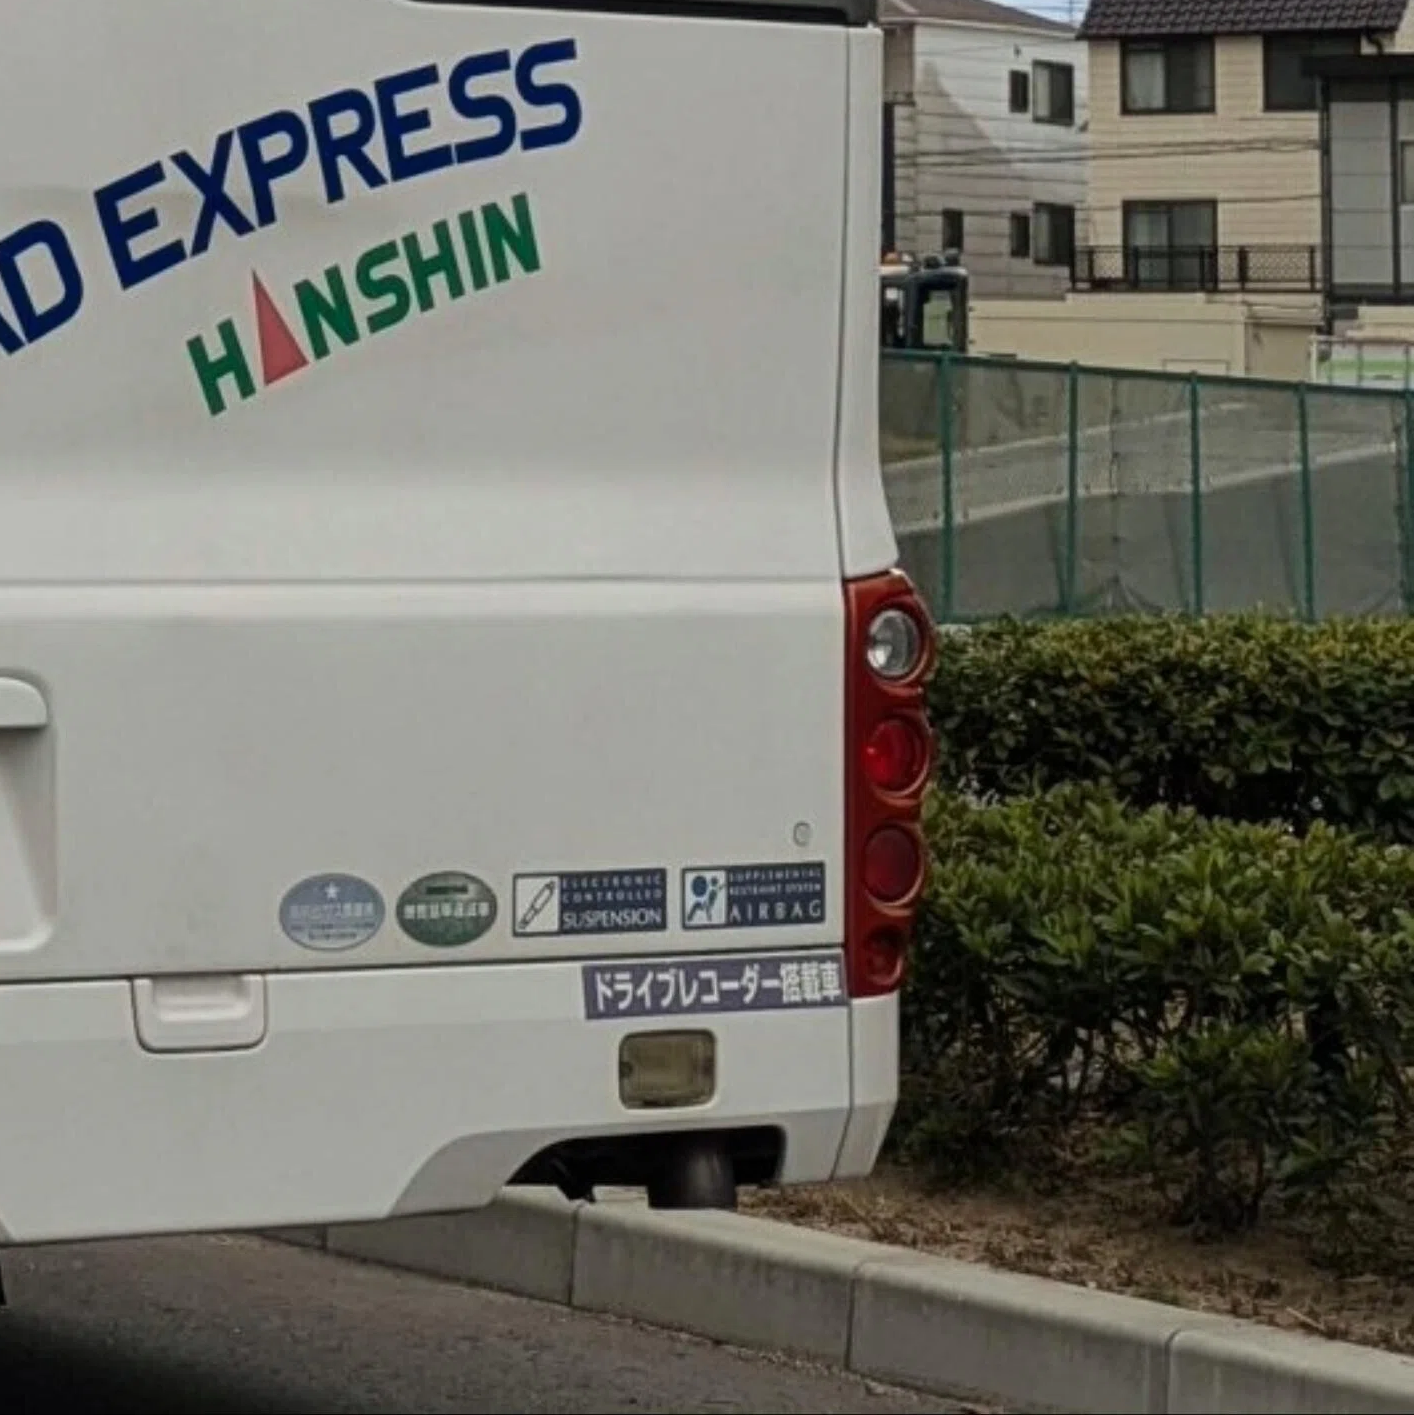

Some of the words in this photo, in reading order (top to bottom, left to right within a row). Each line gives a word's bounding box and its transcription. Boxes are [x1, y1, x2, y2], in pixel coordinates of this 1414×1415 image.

[95, 38, 583, 291] EXPRESS
[185, 192, 542, 416] HANSHIN
[562, 907, 663, 929] SUSPENSION
[729, 899, 822, 923] AIRBAG
